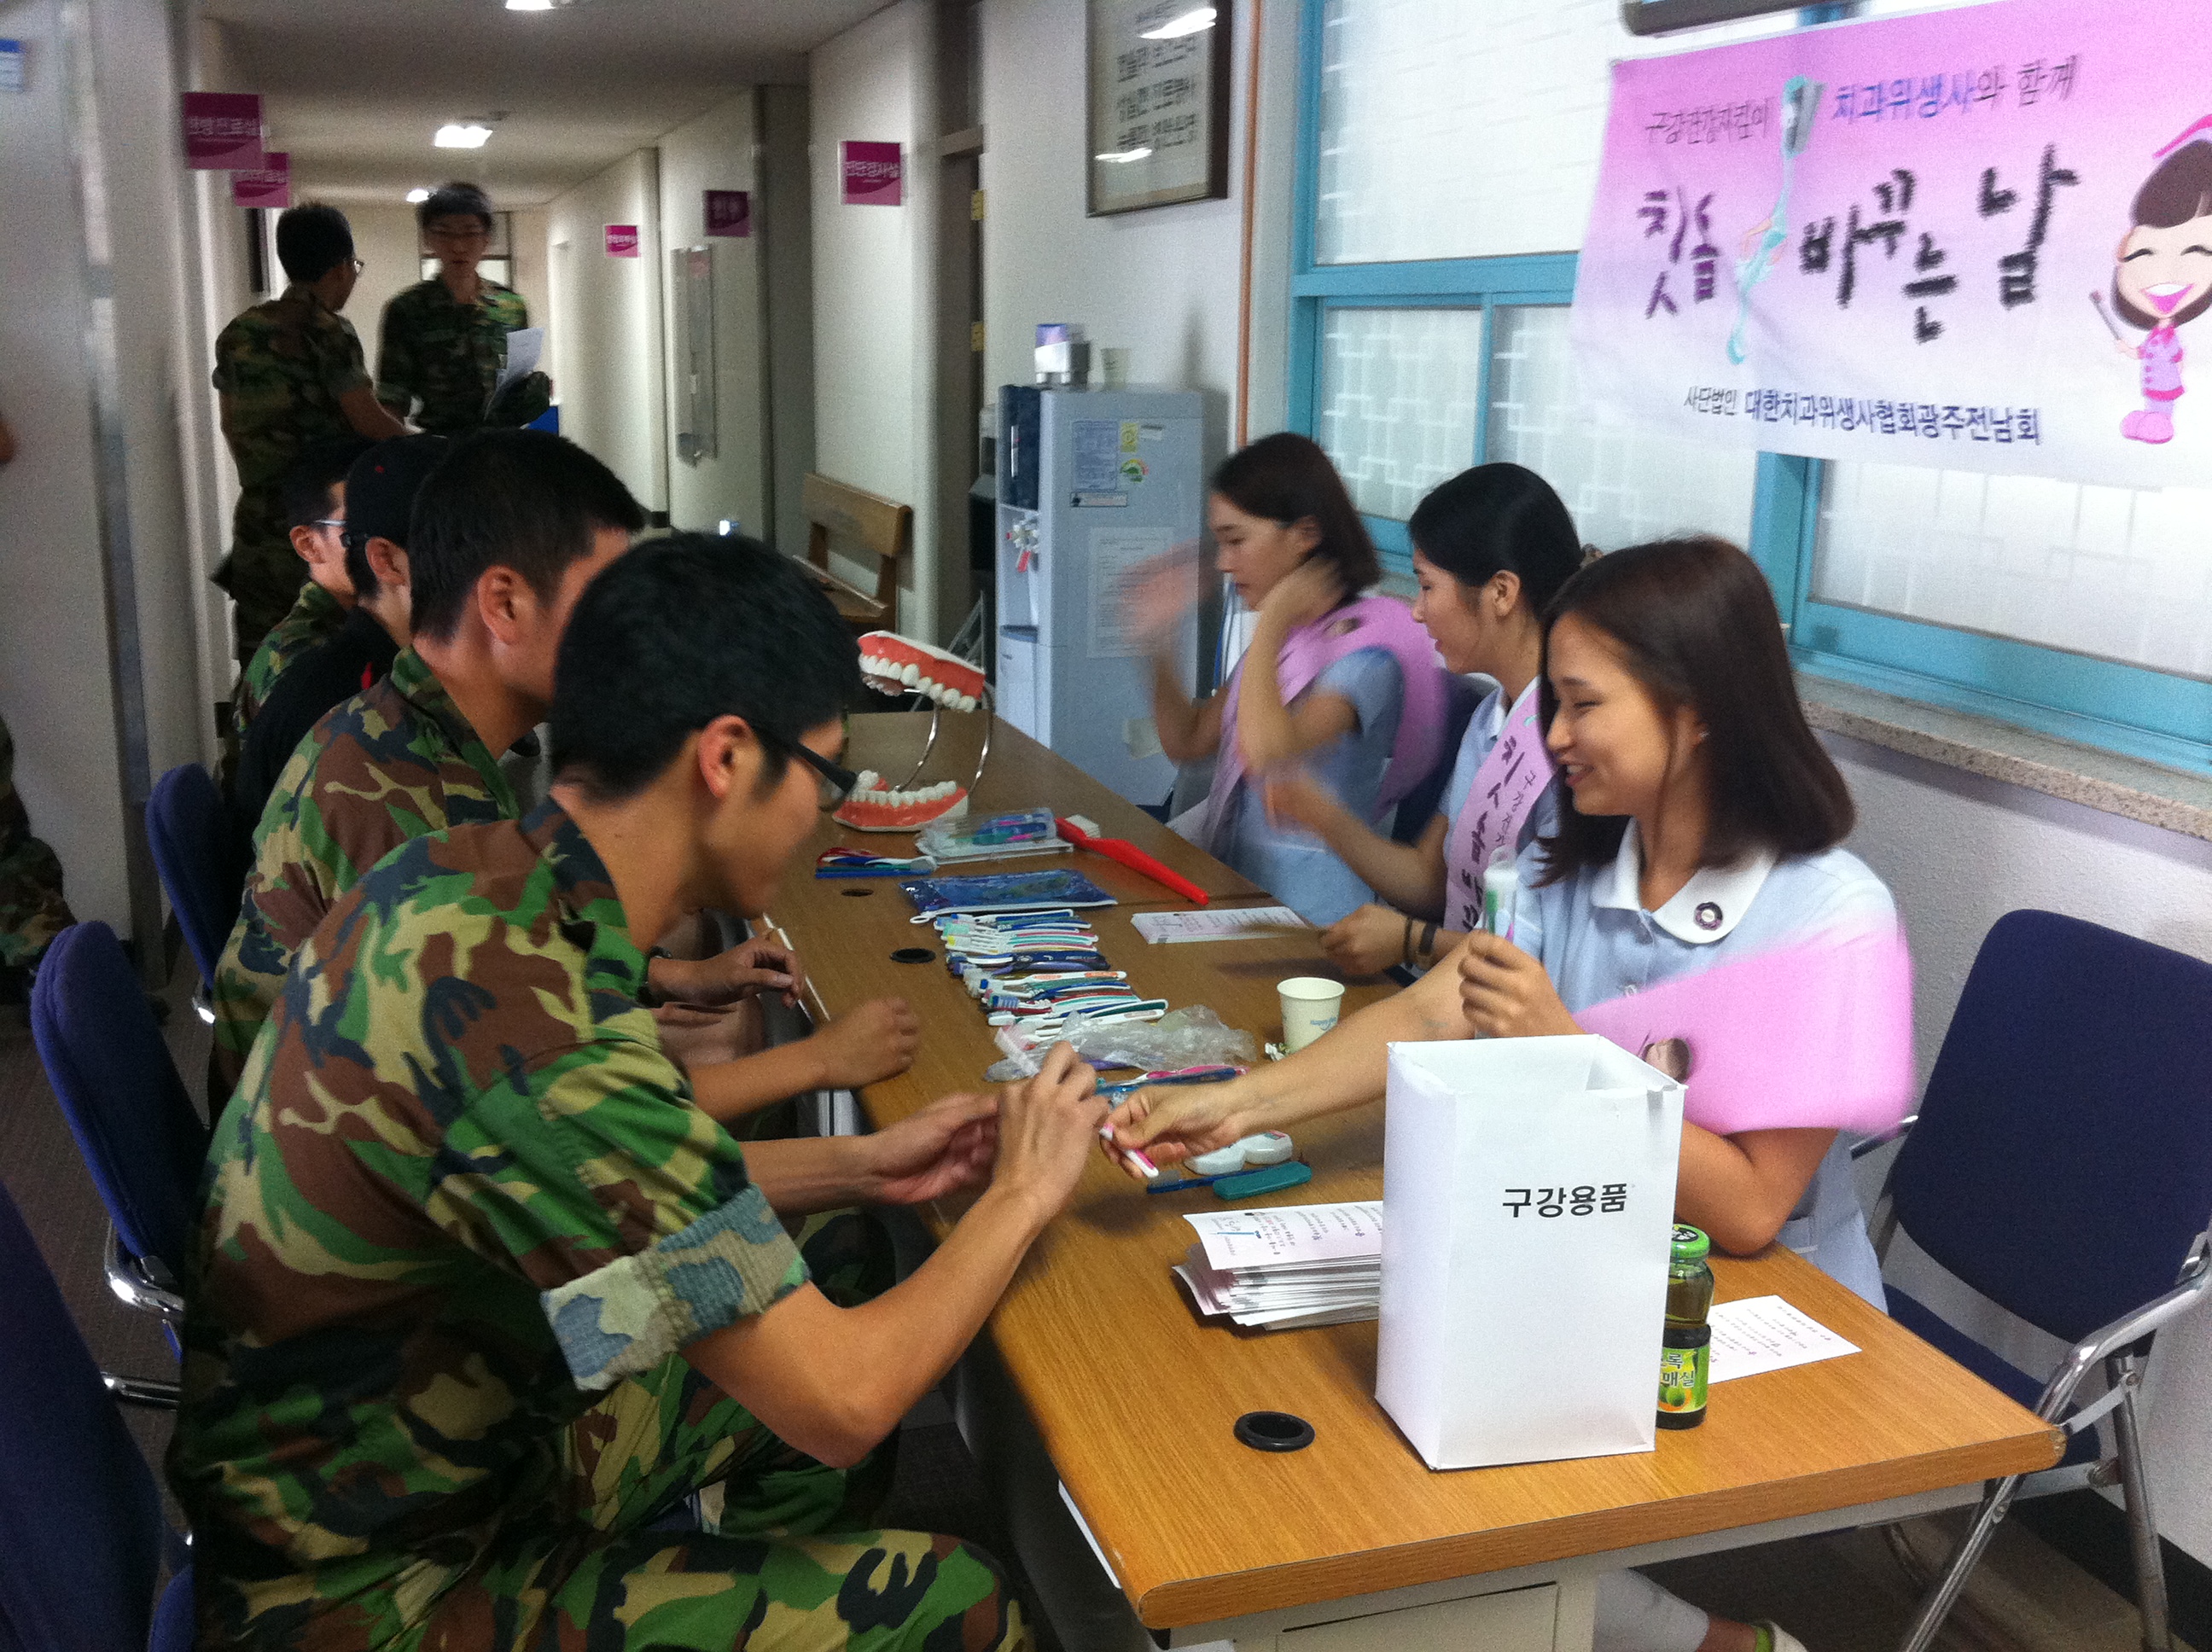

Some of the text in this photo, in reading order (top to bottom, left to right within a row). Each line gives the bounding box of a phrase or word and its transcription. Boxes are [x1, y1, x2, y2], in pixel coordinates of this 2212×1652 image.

[1834, 65, 2011, 124] 치과위생사와
[2017, 55, 2080, 109] 함께
[1799, 168, 1959, 343] 바꾸는
[1977, 145, 2081, 311] 날
[1683, 385, 1738, 416] 사단법인
[1502, 1183, 1628, 1219] 구강용품
[1660, 1353, 1684, 1370] 록
[1662, 1370, 1697, 1388] 매실
